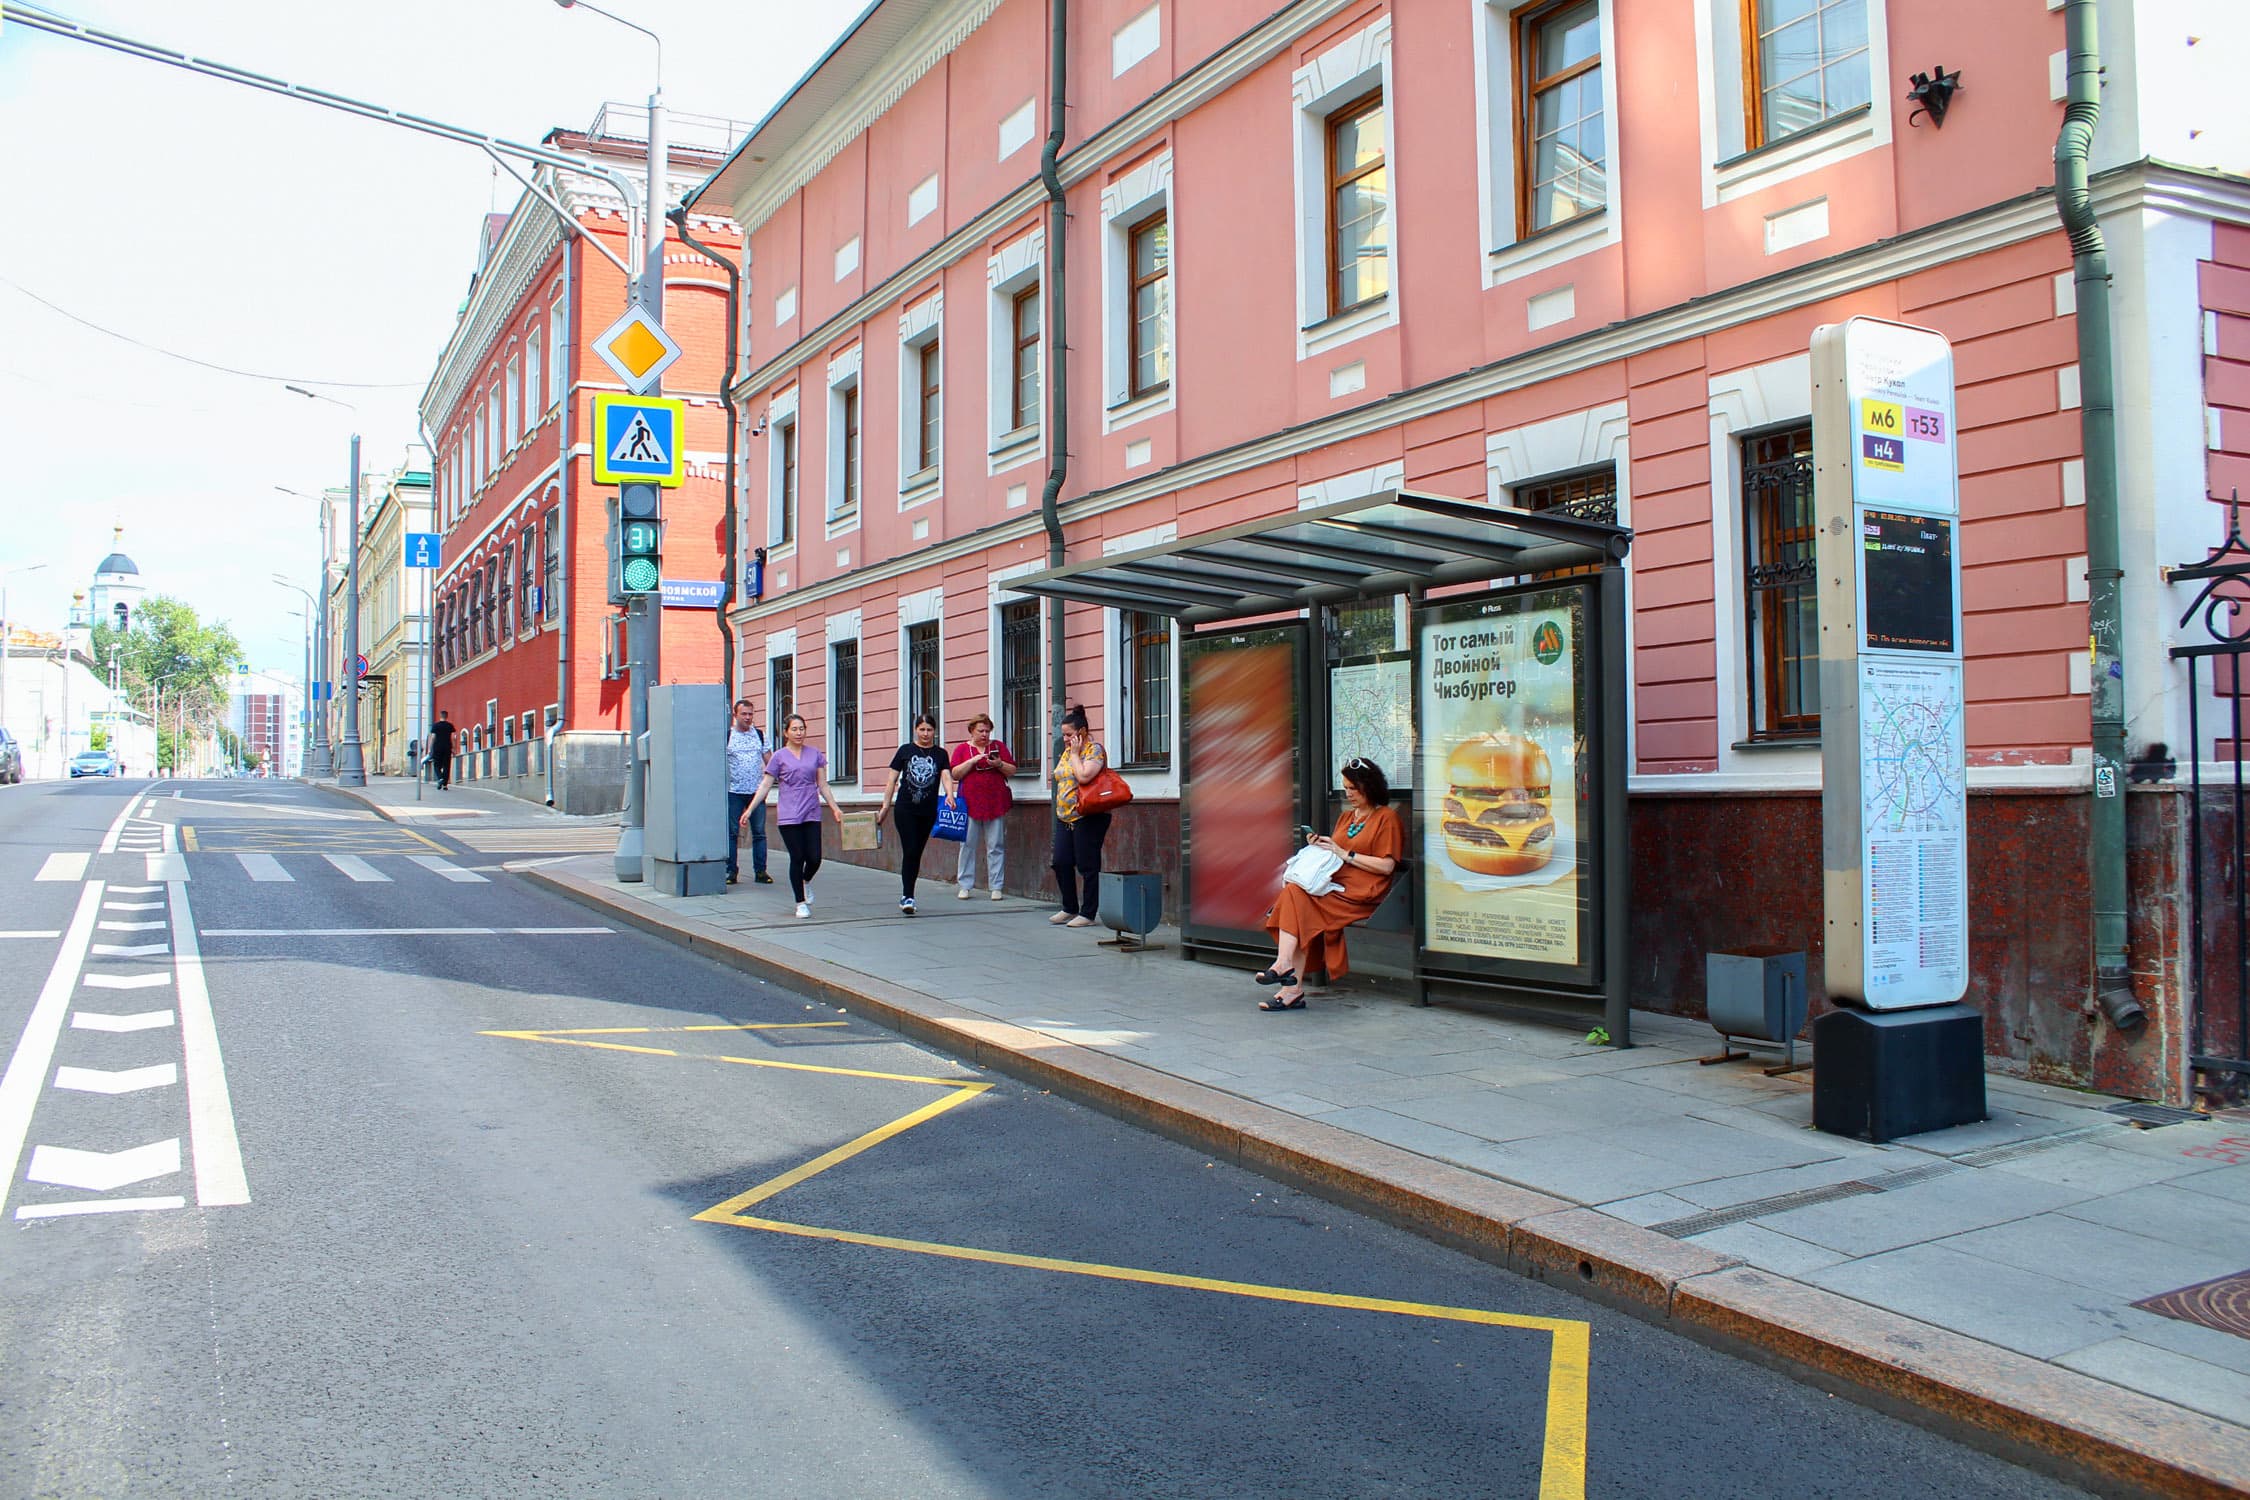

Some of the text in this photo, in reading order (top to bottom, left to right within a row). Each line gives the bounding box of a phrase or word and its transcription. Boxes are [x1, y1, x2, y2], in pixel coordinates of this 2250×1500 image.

[632, 528, 655, 549] 31
[747, 566, 757, 585] 50
[661, 585, 717, 597] ЛОЯМСКОЙ
[1433, 624, 1514, 652] Тот самый
[1433, 650, 1501, 679] Двойной
[1434, 679, 1517, 701] Чизбургер
